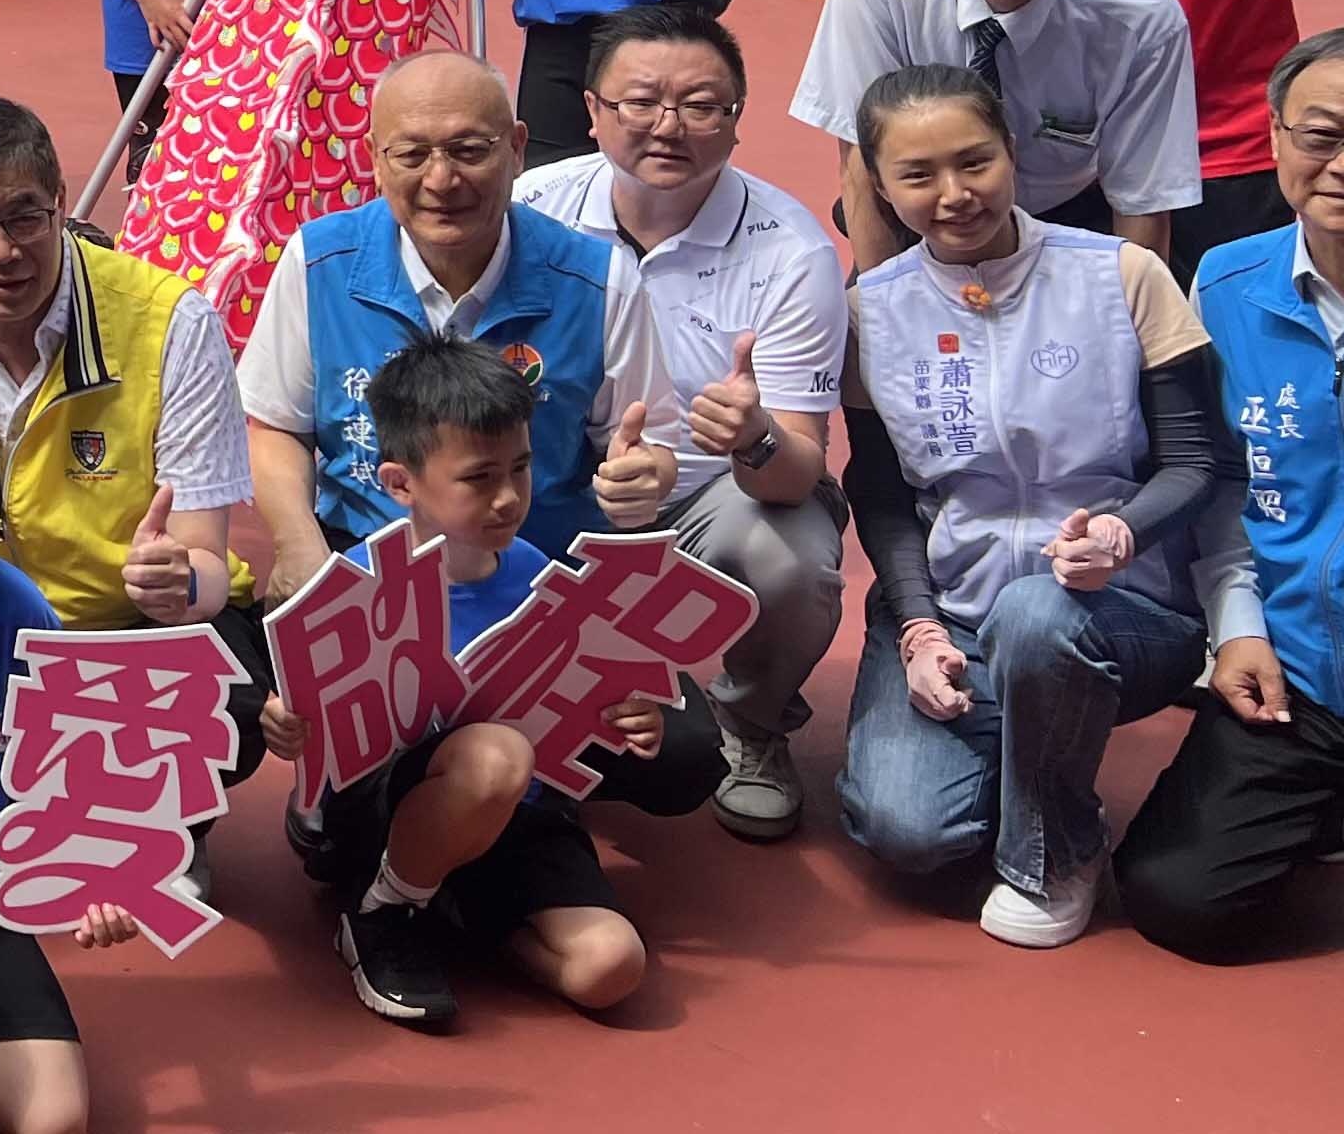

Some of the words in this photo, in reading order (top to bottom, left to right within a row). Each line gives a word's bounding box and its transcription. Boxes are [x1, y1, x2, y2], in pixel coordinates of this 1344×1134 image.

[747, 219, 780, 236] FILA
[939, 356, 982, 457] 蕭詠萱
[1274, 381, 1305, 440] 處長
